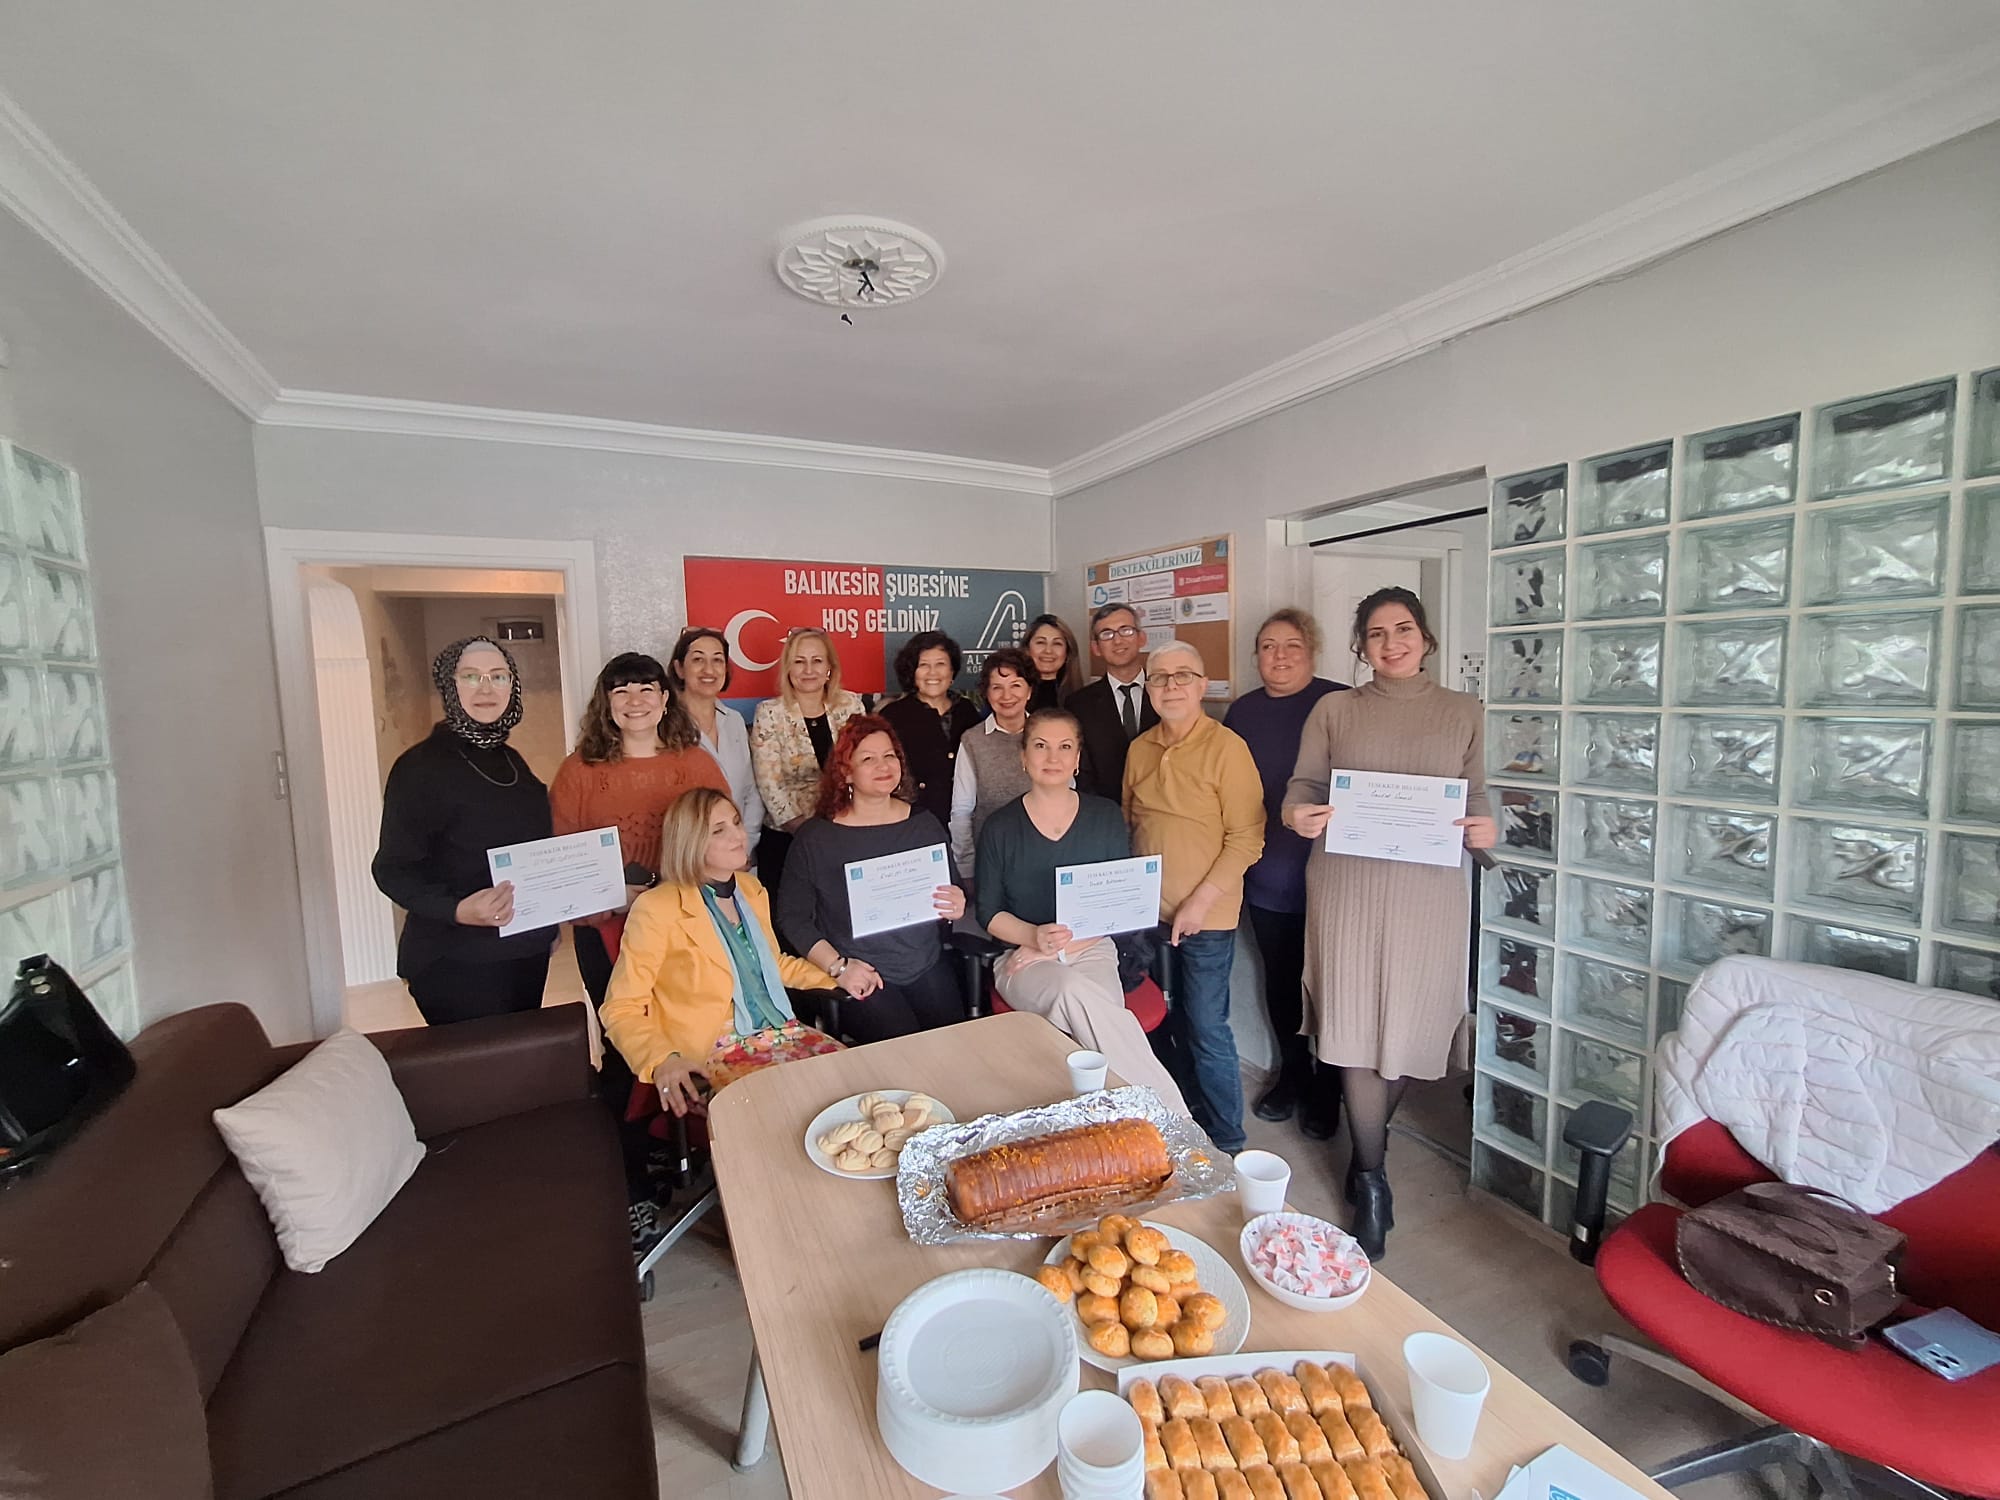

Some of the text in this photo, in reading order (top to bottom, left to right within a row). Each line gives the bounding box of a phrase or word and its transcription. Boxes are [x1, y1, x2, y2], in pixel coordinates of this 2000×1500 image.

[784, 567, 970, 602] BALIKESİR ŞUBESİ'NE
[822, 604, 941, 639] HOŞ GELDİNİZ
